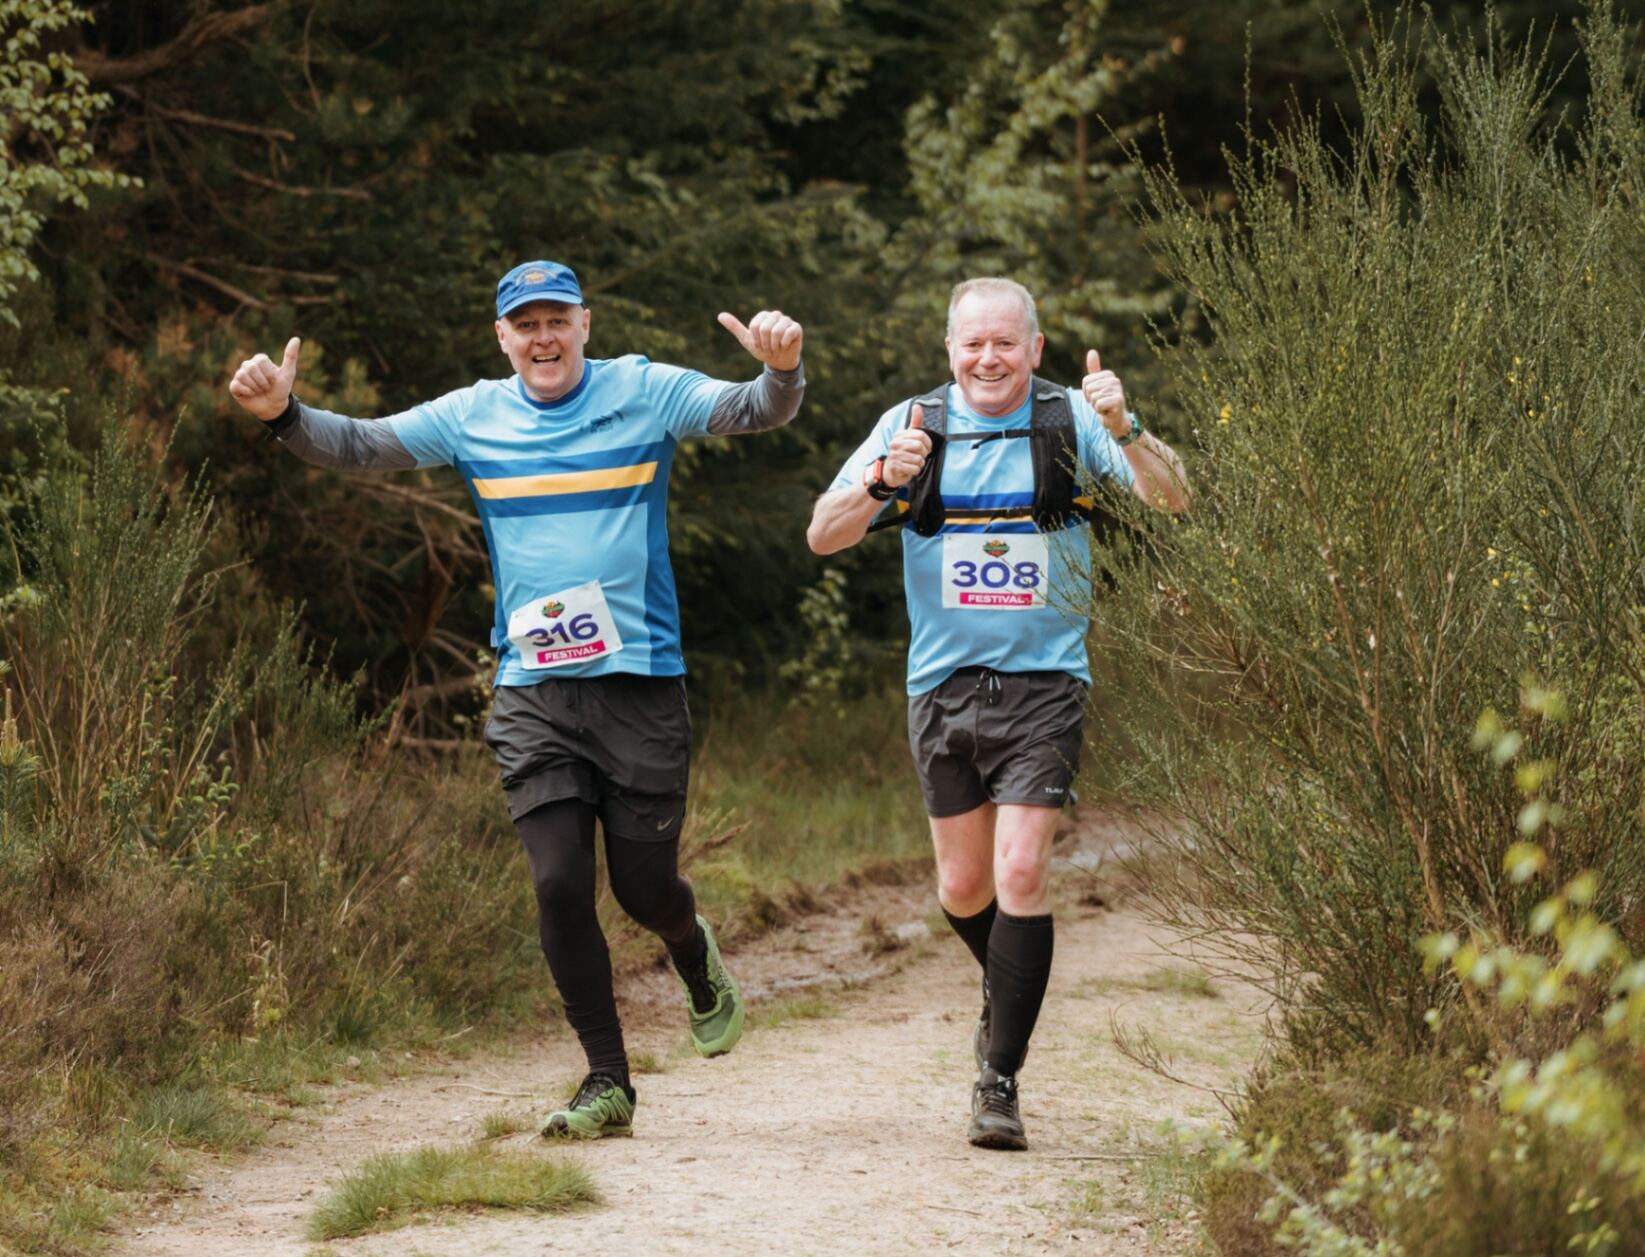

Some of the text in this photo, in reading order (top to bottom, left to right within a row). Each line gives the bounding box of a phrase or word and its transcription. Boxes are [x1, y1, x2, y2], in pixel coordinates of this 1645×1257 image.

[952, 560, 1040, 589] 308
[968, 594, 1025, 604] FESTIVAL
[525, 613, 599, 647] 316
[544, 645, 598, 662] FESTIVAL
